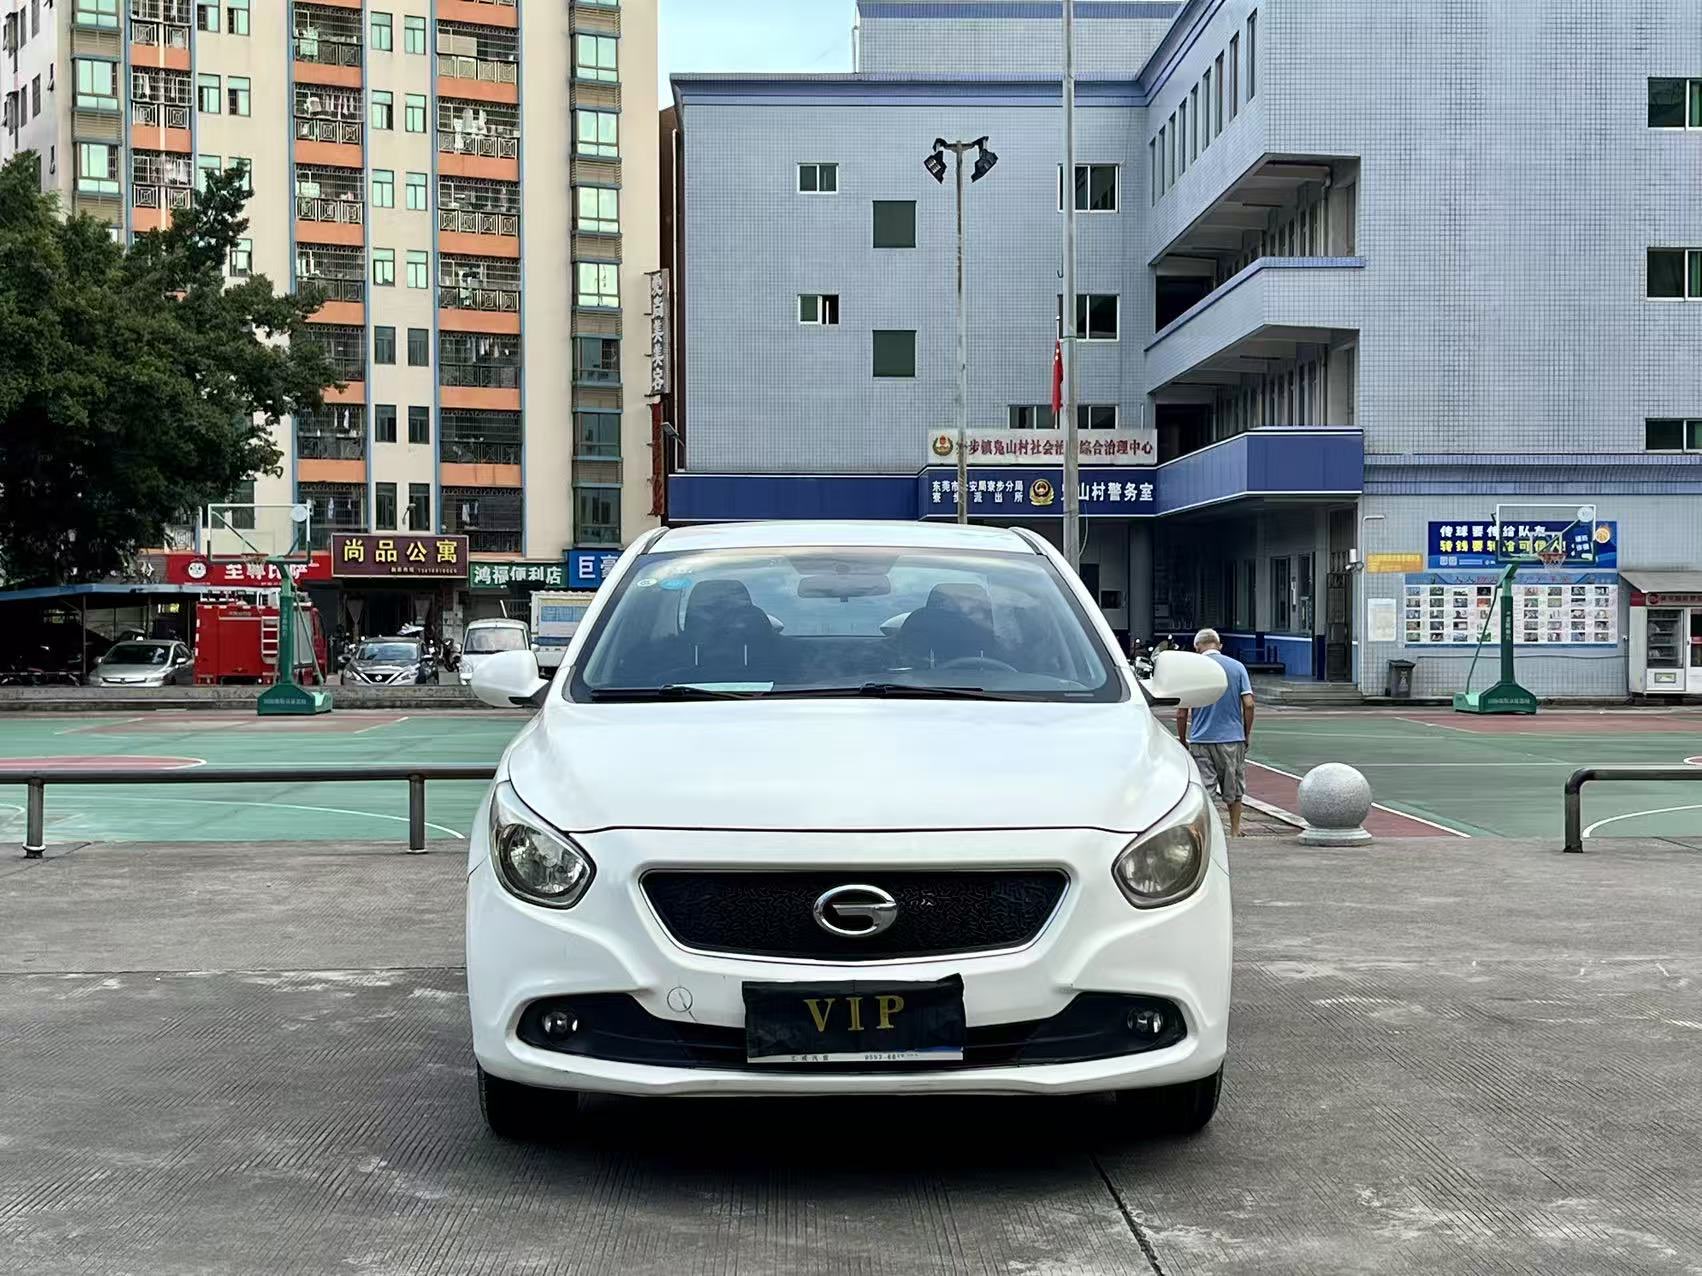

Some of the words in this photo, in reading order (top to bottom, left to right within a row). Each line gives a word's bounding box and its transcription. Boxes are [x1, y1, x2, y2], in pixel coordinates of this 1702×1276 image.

[1061, 482, 1154, 501] 山村警务室
[344, 538, 458, 562] 尚品公寓
[474, 566, 562, 584] 鸿福便利店
[803, 994, 905, 1033] VIP
